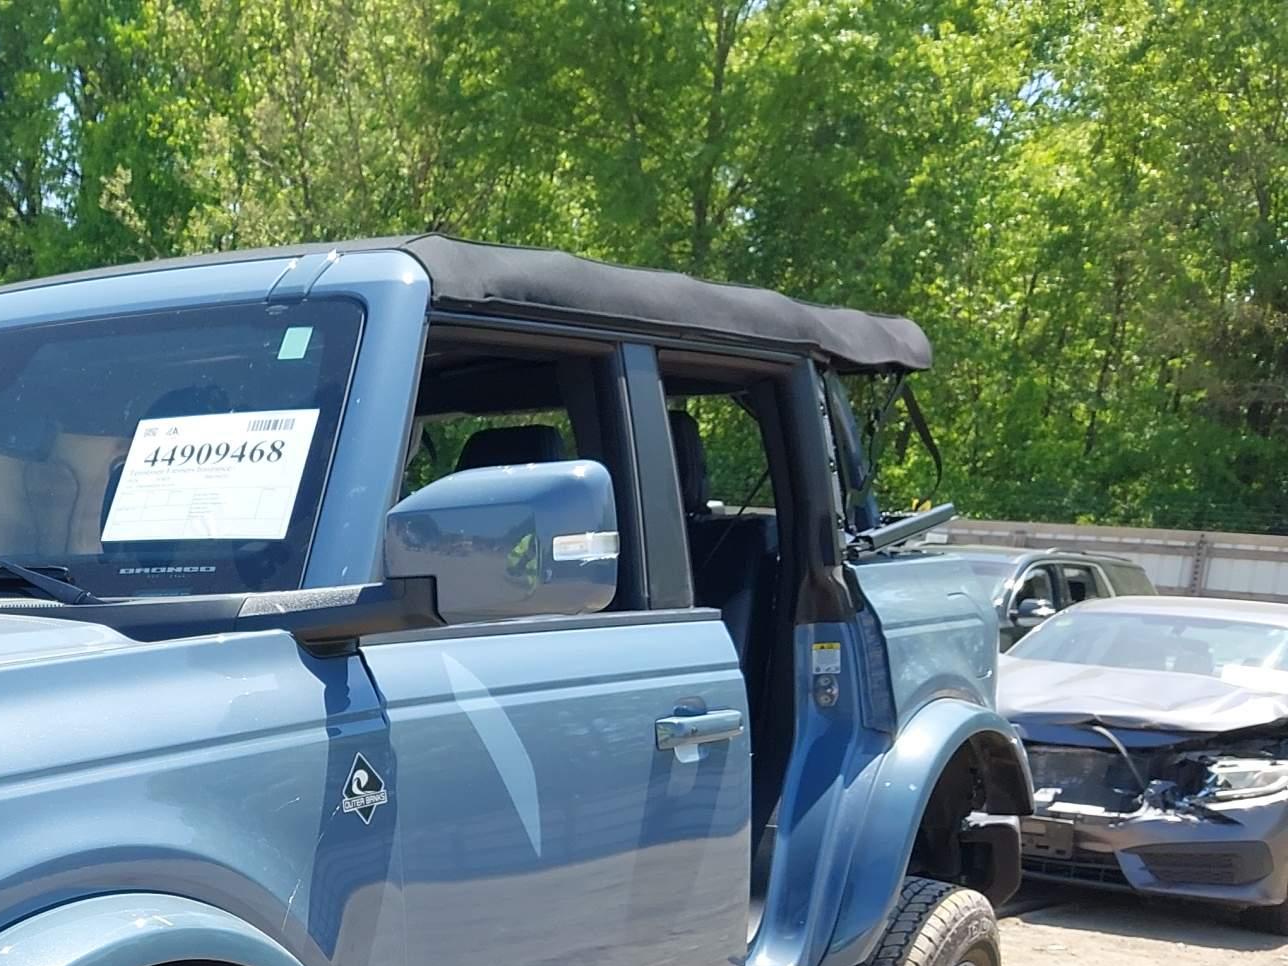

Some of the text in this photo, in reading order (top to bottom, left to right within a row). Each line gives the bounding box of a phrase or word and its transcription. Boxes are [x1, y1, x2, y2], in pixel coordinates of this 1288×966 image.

[143, 439, 286, 467] 44909468
[118, 565, 217, 575] BRONCO
[345, 793, 385, 809] OUTER BANKS
